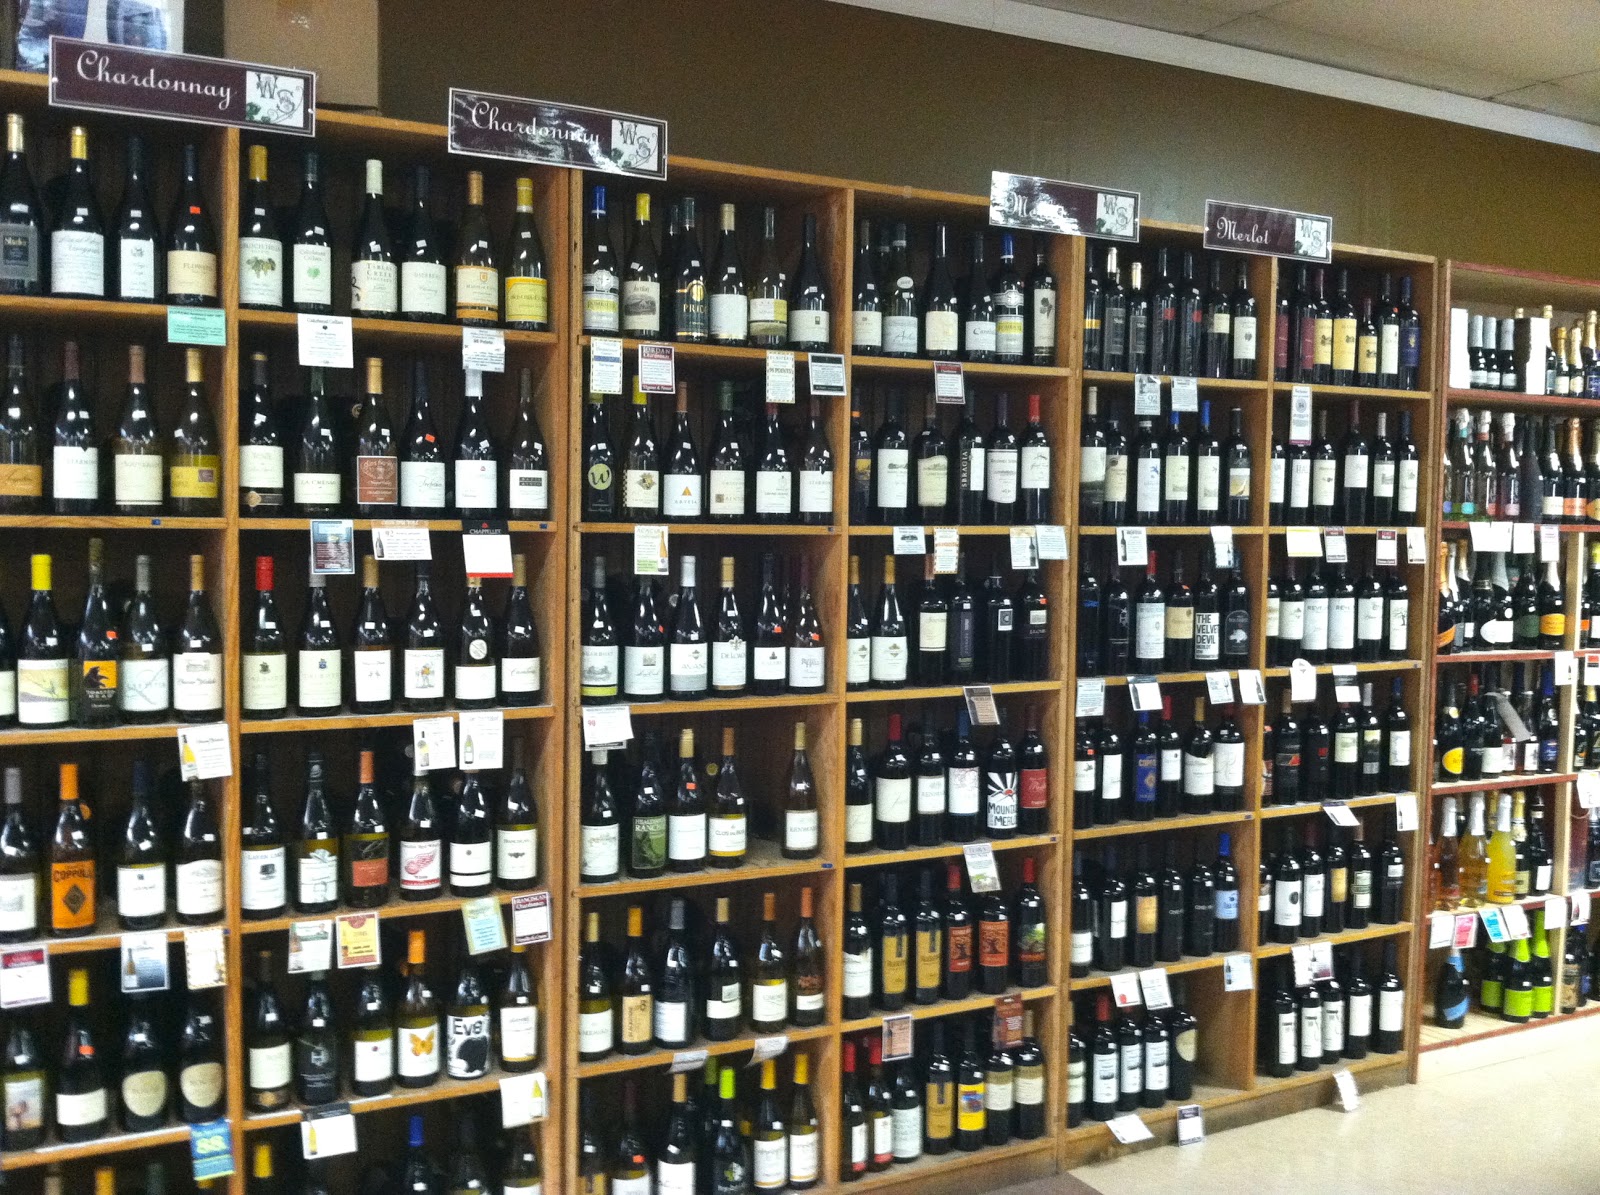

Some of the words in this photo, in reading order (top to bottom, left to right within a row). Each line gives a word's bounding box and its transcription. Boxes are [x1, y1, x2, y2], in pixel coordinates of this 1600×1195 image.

[76, 50, 237, 110] Chardonnay
[1216, 216, 1270, 244] Merlot
[961, 450, 969, 489] SBRAGIA
[1196, 614, 1212, 624] THE
[1196, 635, 1216, 644] DEVIL
